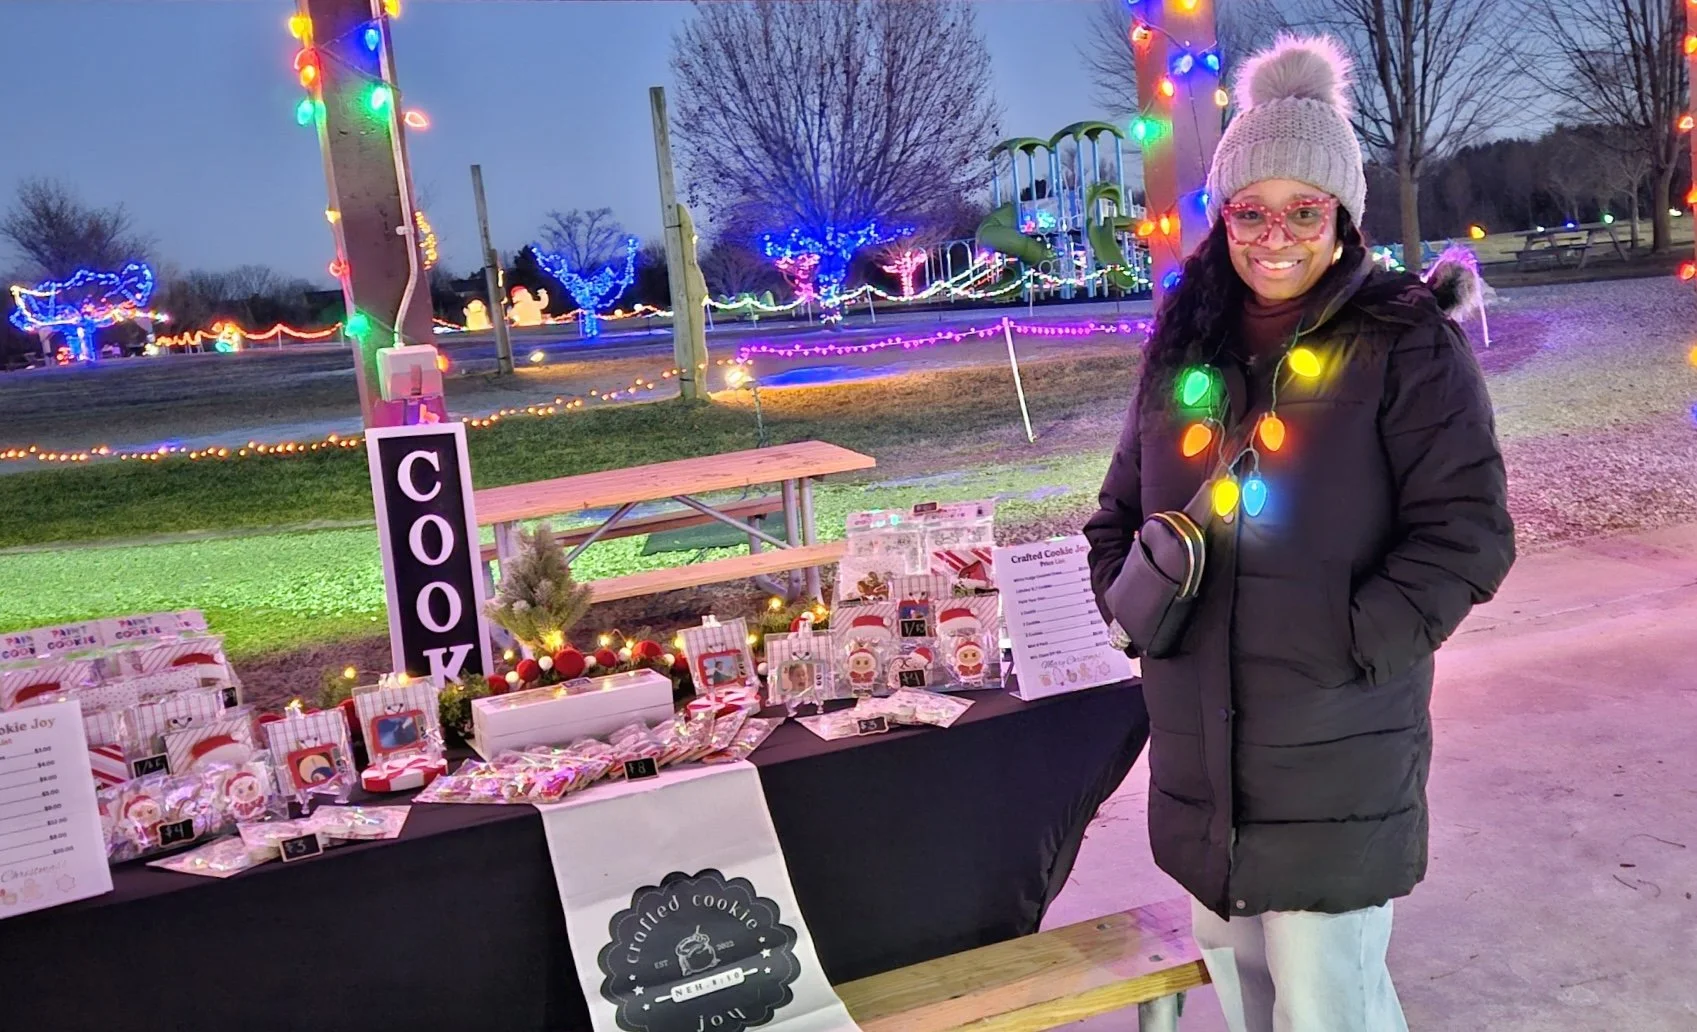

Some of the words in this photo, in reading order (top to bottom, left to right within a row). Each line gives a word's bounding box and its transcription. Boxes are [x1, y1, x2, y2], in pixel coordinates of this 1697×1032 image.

[1011, 551, 1042, 564] Crafted
[1044, 546, 1073, 558] Cookie
[397, 450, 475, 689] COOK
[115, 626, 162, 640] COOKIE
[47, 635, 96, 650] COOKIE
[31, 718, 55, 730] Joy
[165, 823, 185, 838] $4
[626, 894, 680, 964] crafted
[692, 894, 758, 930] cookie
[654, 959, 669, 970] EST
